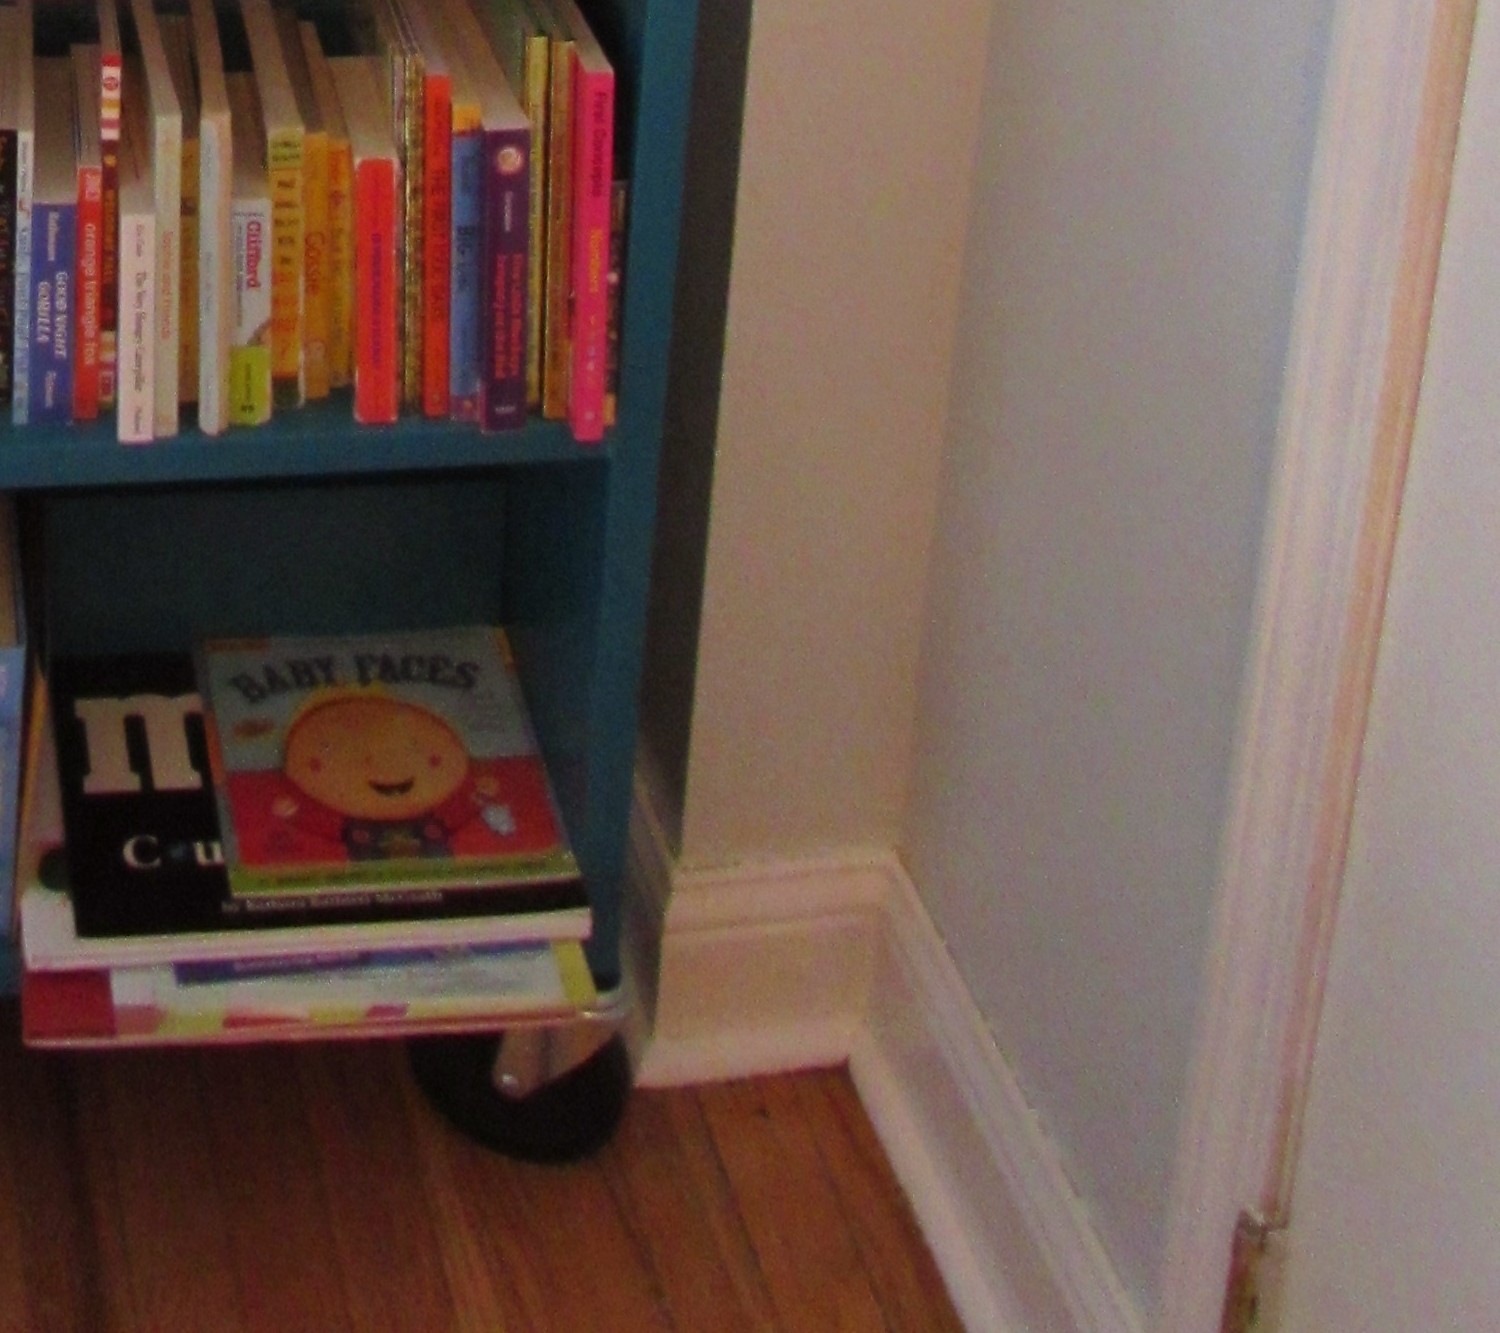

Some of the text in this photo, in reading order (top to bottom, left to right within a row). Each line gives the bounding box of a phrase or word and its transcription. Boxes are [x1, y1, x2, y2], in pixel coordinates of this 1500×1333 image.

[245, 220, 263, 290] Clifford
[79, 222, 98, 365] orange triangle fox
[229, 651, 480, 705] BABY FACES
